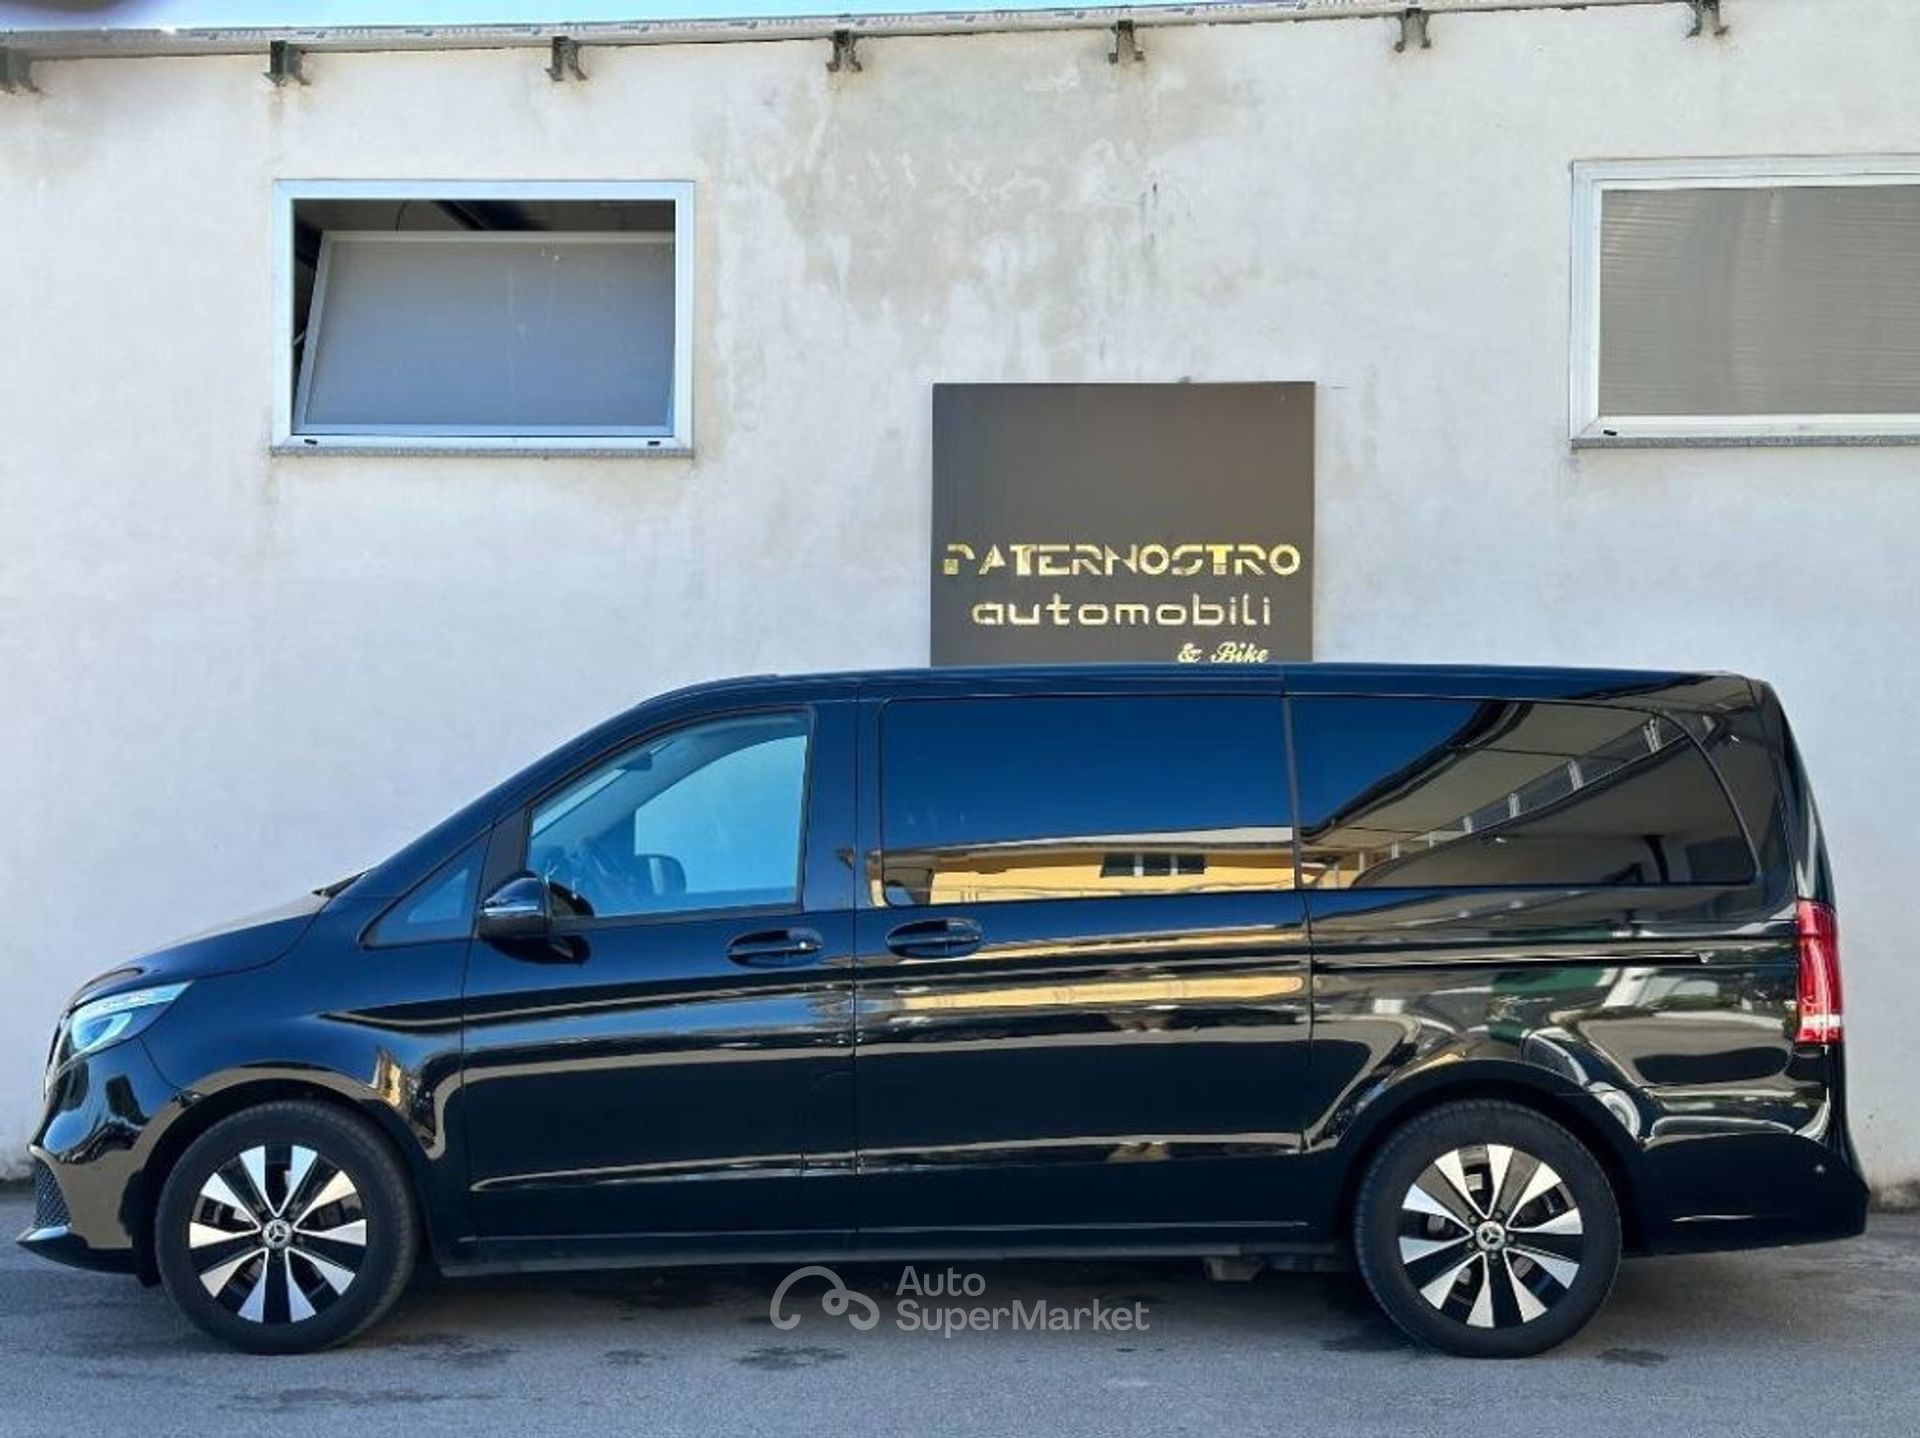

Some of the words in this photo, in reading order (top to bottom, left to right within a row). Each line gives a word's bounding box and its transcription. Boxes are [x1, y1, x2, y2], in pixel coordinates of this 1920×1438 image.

[943, 544, 1301, 576] PATERNOSTRO
[972, 593, 1272, 626] automobili
[1177, 643, 1202, 663] &
[1211, 641, 1269, 663] Bike
